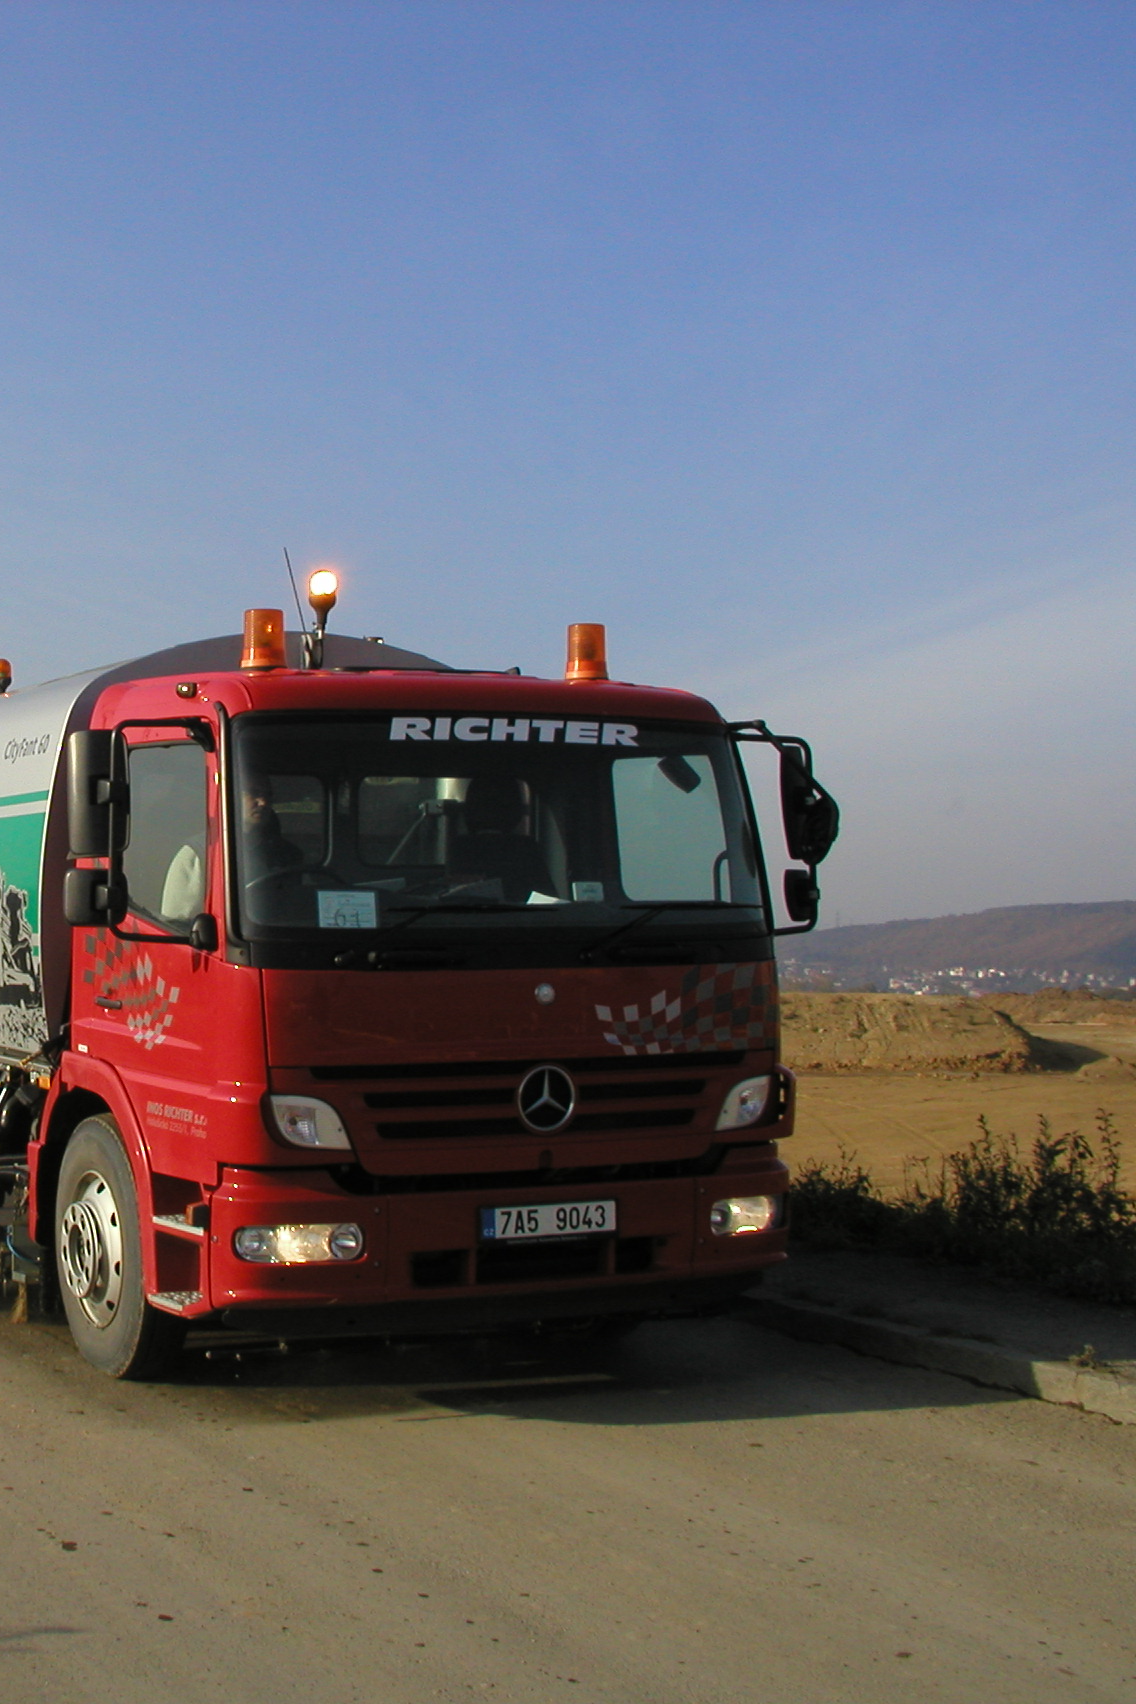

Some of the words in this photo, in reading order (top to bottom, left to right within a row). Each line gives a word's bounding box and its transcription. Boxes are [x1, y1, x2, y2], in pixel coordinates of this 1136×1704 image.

[389, 716, 639, 747] RICHTER
[483, 1228, 494, 1236] CZ
[500, 1208, 539, 1235] 7A5
[556, 1205, 605, 1231] 9043
